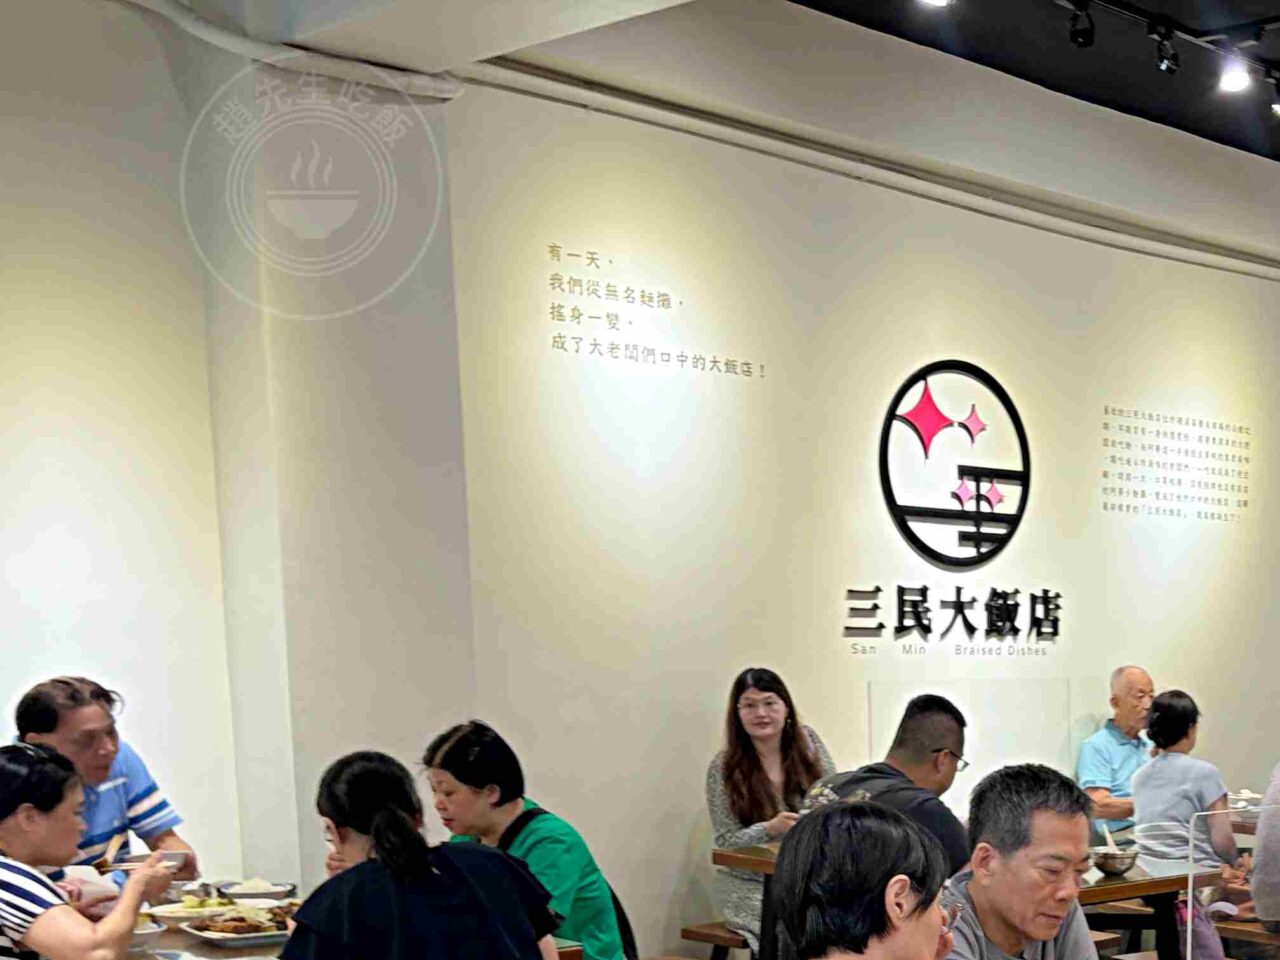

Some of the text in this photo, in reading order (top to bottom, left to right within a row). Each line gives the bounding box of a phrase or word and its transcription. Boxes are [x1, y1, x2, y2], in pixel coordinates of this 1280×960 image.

[843, 584, 1064, 642] 三民大飯店
[851, 643, 1047, 656] San Min Braised Dishes
